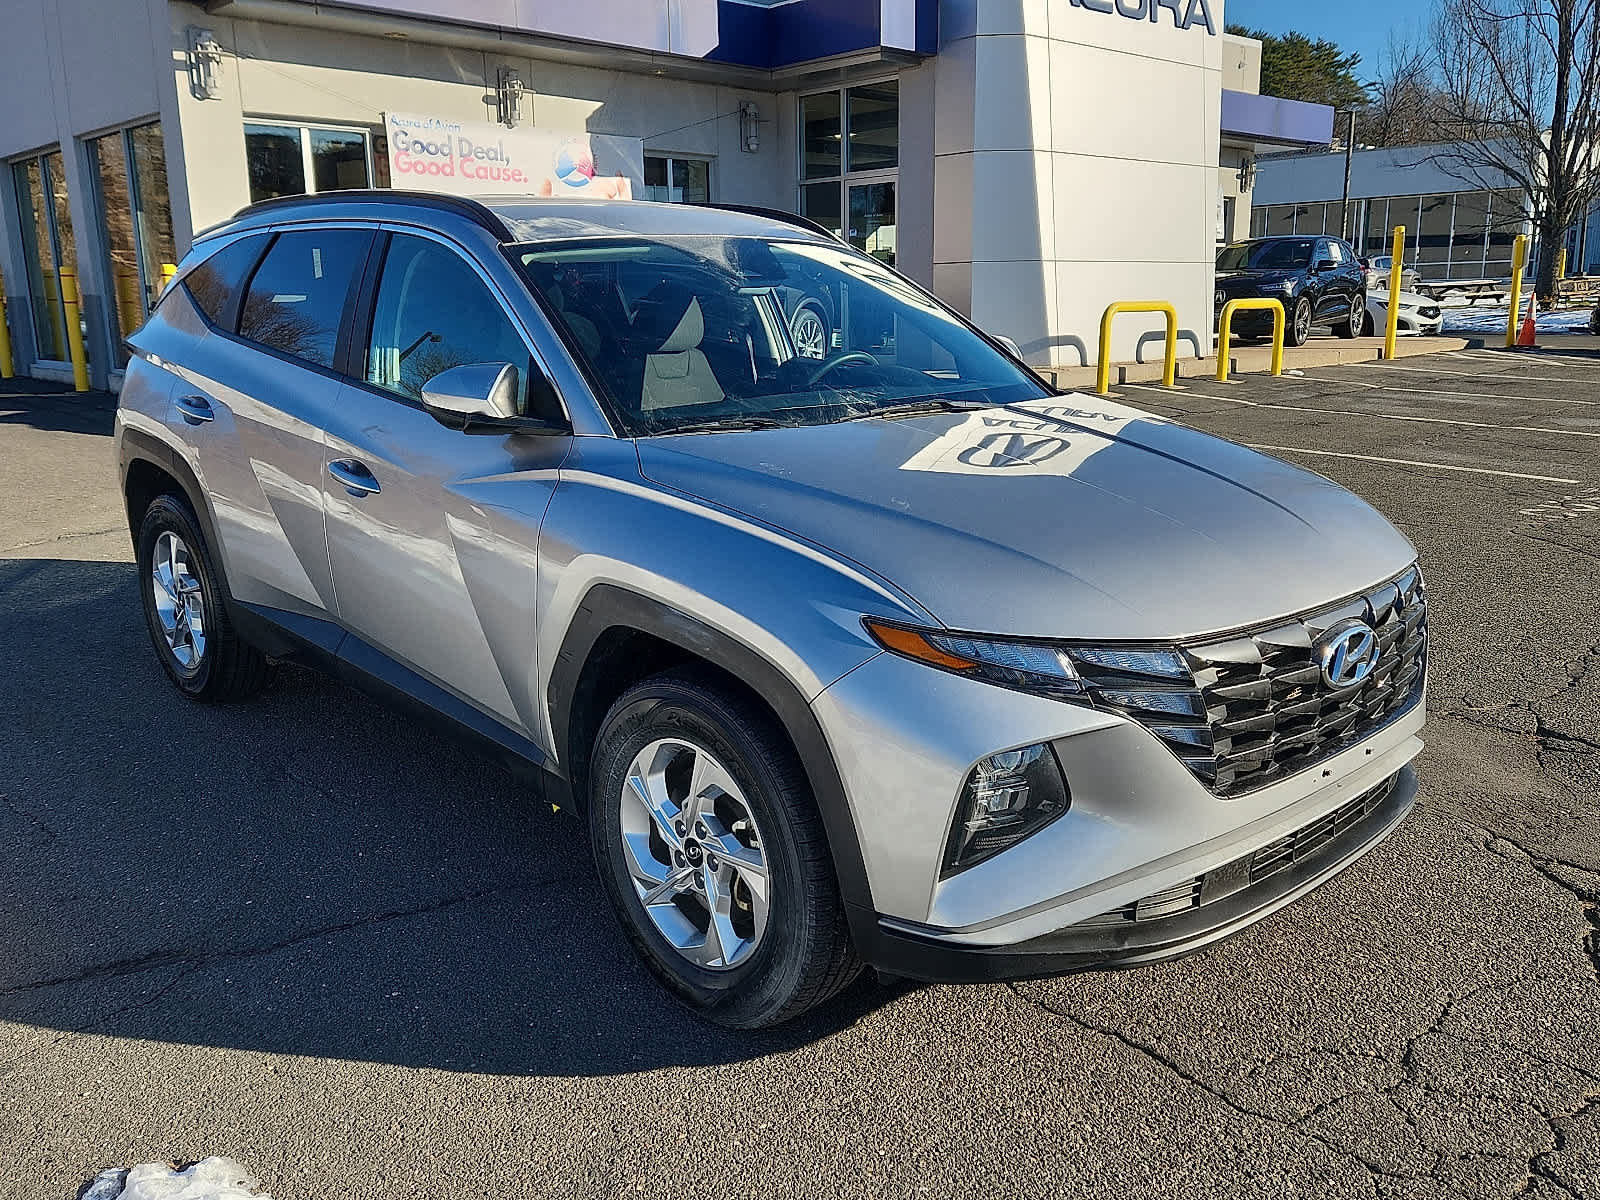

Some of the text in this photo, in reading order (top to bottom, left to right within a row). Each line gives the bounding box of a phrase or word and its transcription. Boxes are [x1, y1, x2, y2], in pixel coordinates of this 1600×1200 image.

[391, 115, 421, 128] Acura
[424, 119, 433, 129] of
[392, 130, 452, 157] Good
[458, 136, 511, 166] Deal,
[394, 150, 455, 177] Good
[460, 156, 529, 183] Cause.
